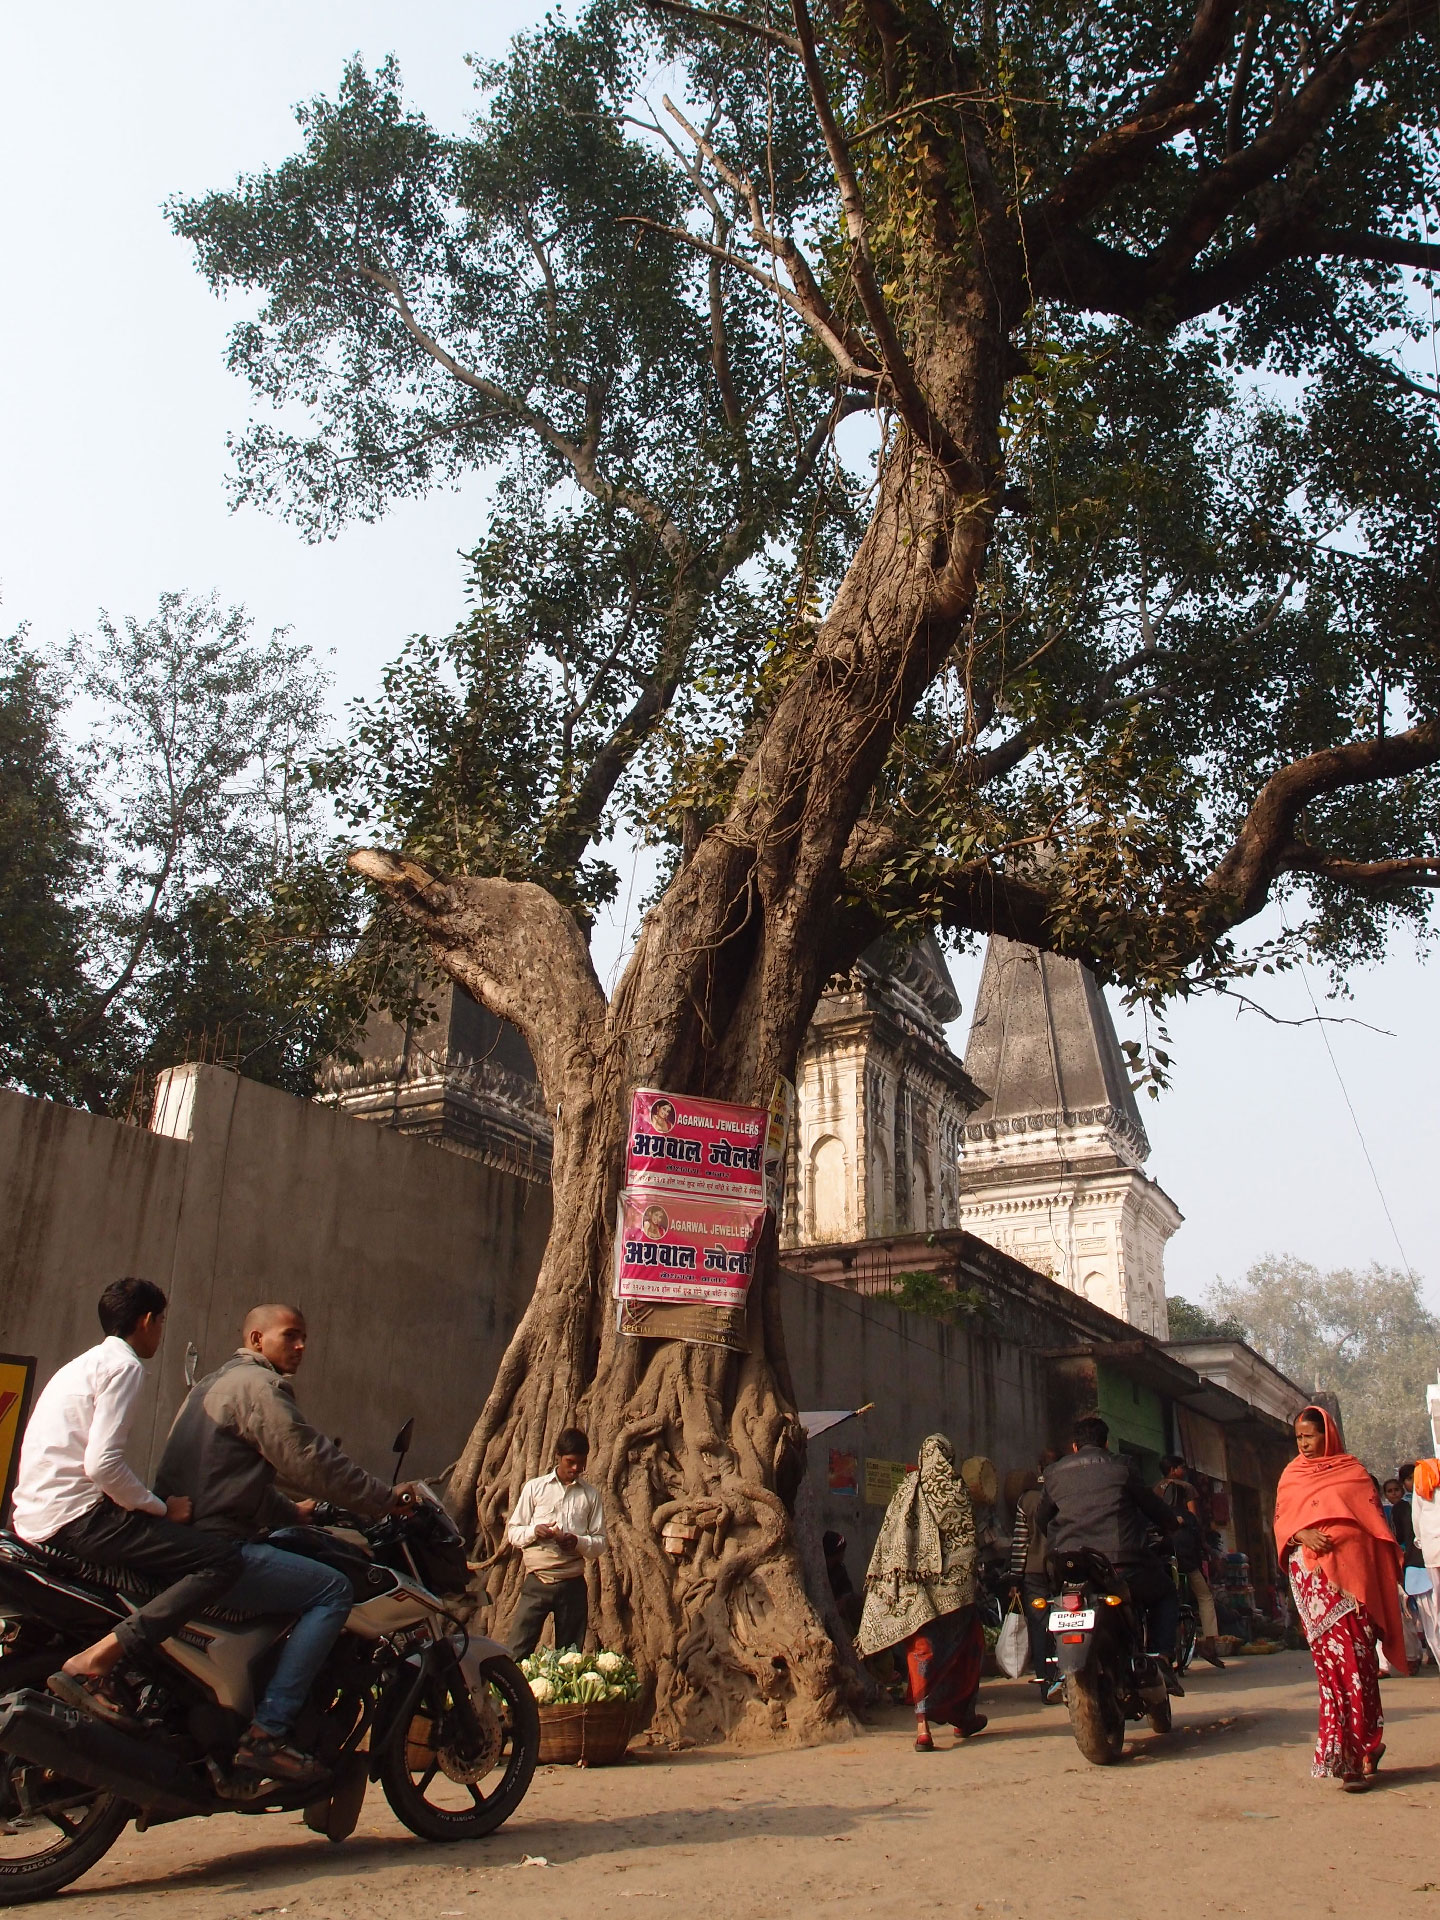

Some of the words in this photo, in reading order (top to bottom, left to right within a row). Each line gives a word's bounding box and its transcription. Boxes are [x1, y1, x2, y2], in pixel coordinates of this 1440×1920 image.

[677, 1114, 714, 1129] AGARWAL
[716, 1119, 759, 1136] JEWELLERS
[632, 1132, 702, 1164] अग्रवाल
[708, 1139, 763, 1172] ज्वेलर्स
[670, 1219, 708, 1234] AGARWAL
[624, 1240, 697, 1270] अग्रवाल
[622, 1324, 651, 1334] SPECIAL
[22, 1857, 57, 1873] SPORTS
